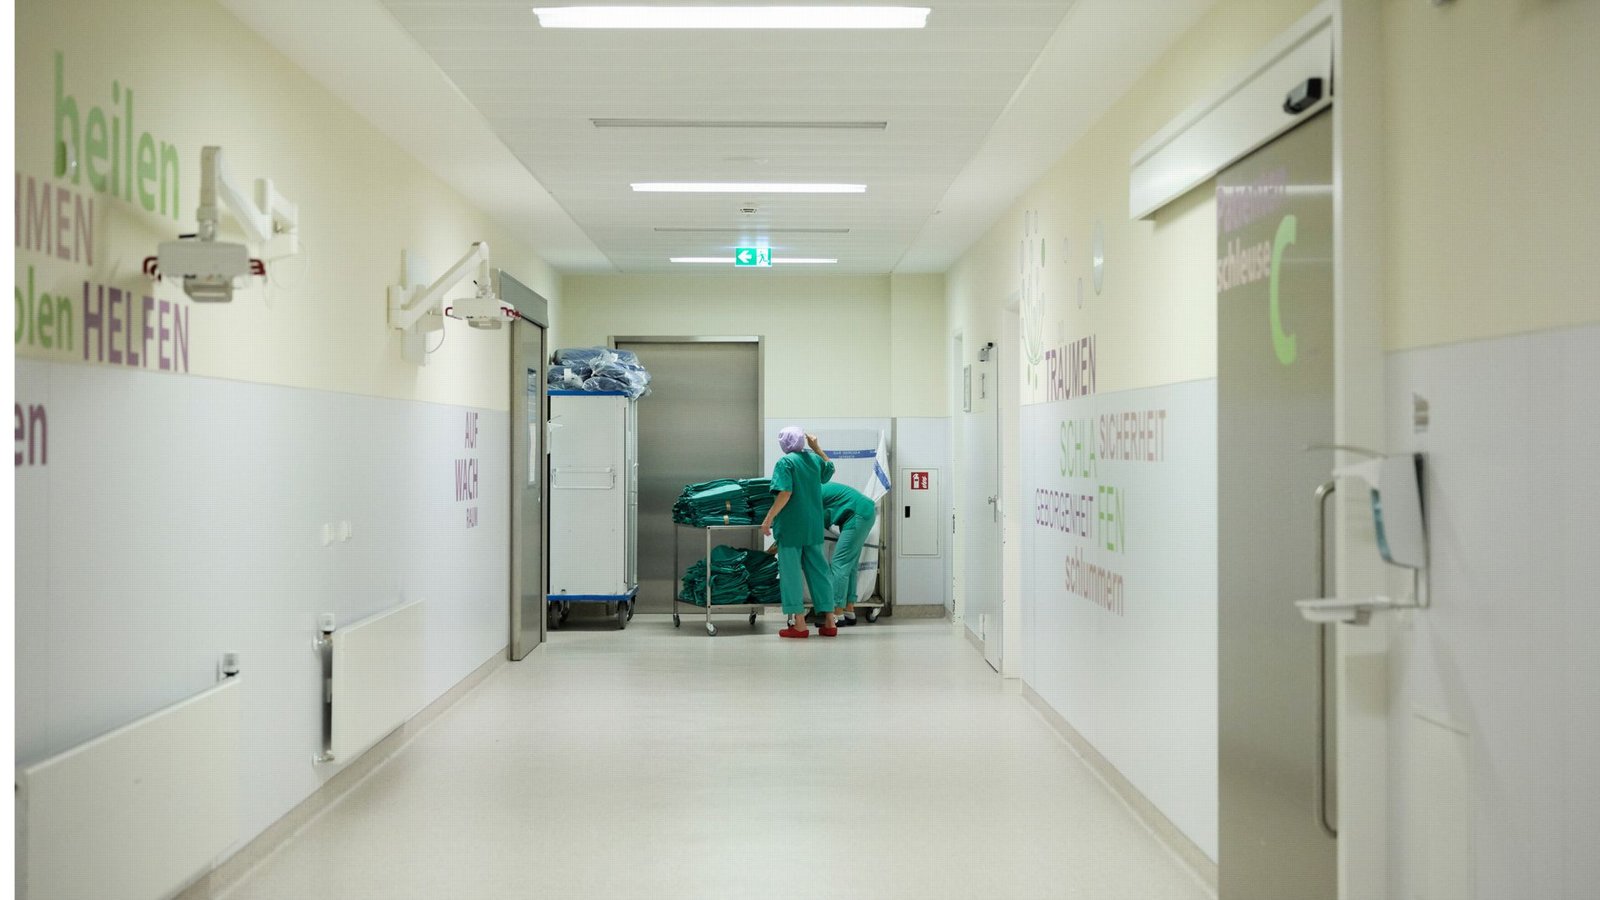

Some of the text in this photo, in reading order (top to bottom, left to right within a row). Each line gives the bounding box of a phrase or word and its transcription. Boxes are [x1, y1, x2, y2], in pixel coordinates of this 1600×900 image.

[53, 50, 180, 219] heilen
[83, 281, 189, 373] HELFEN
[464, 411, 479, 449] AUF
[1060, 417, 1098, 479] SCHLA
[1100, 410, 1167, 462] SICHERHEIT
[455, 458, 479, 502] WACH
[1098, 485, 1125, 554] FEN
[1065, 546, 1124, 616] schlummern
